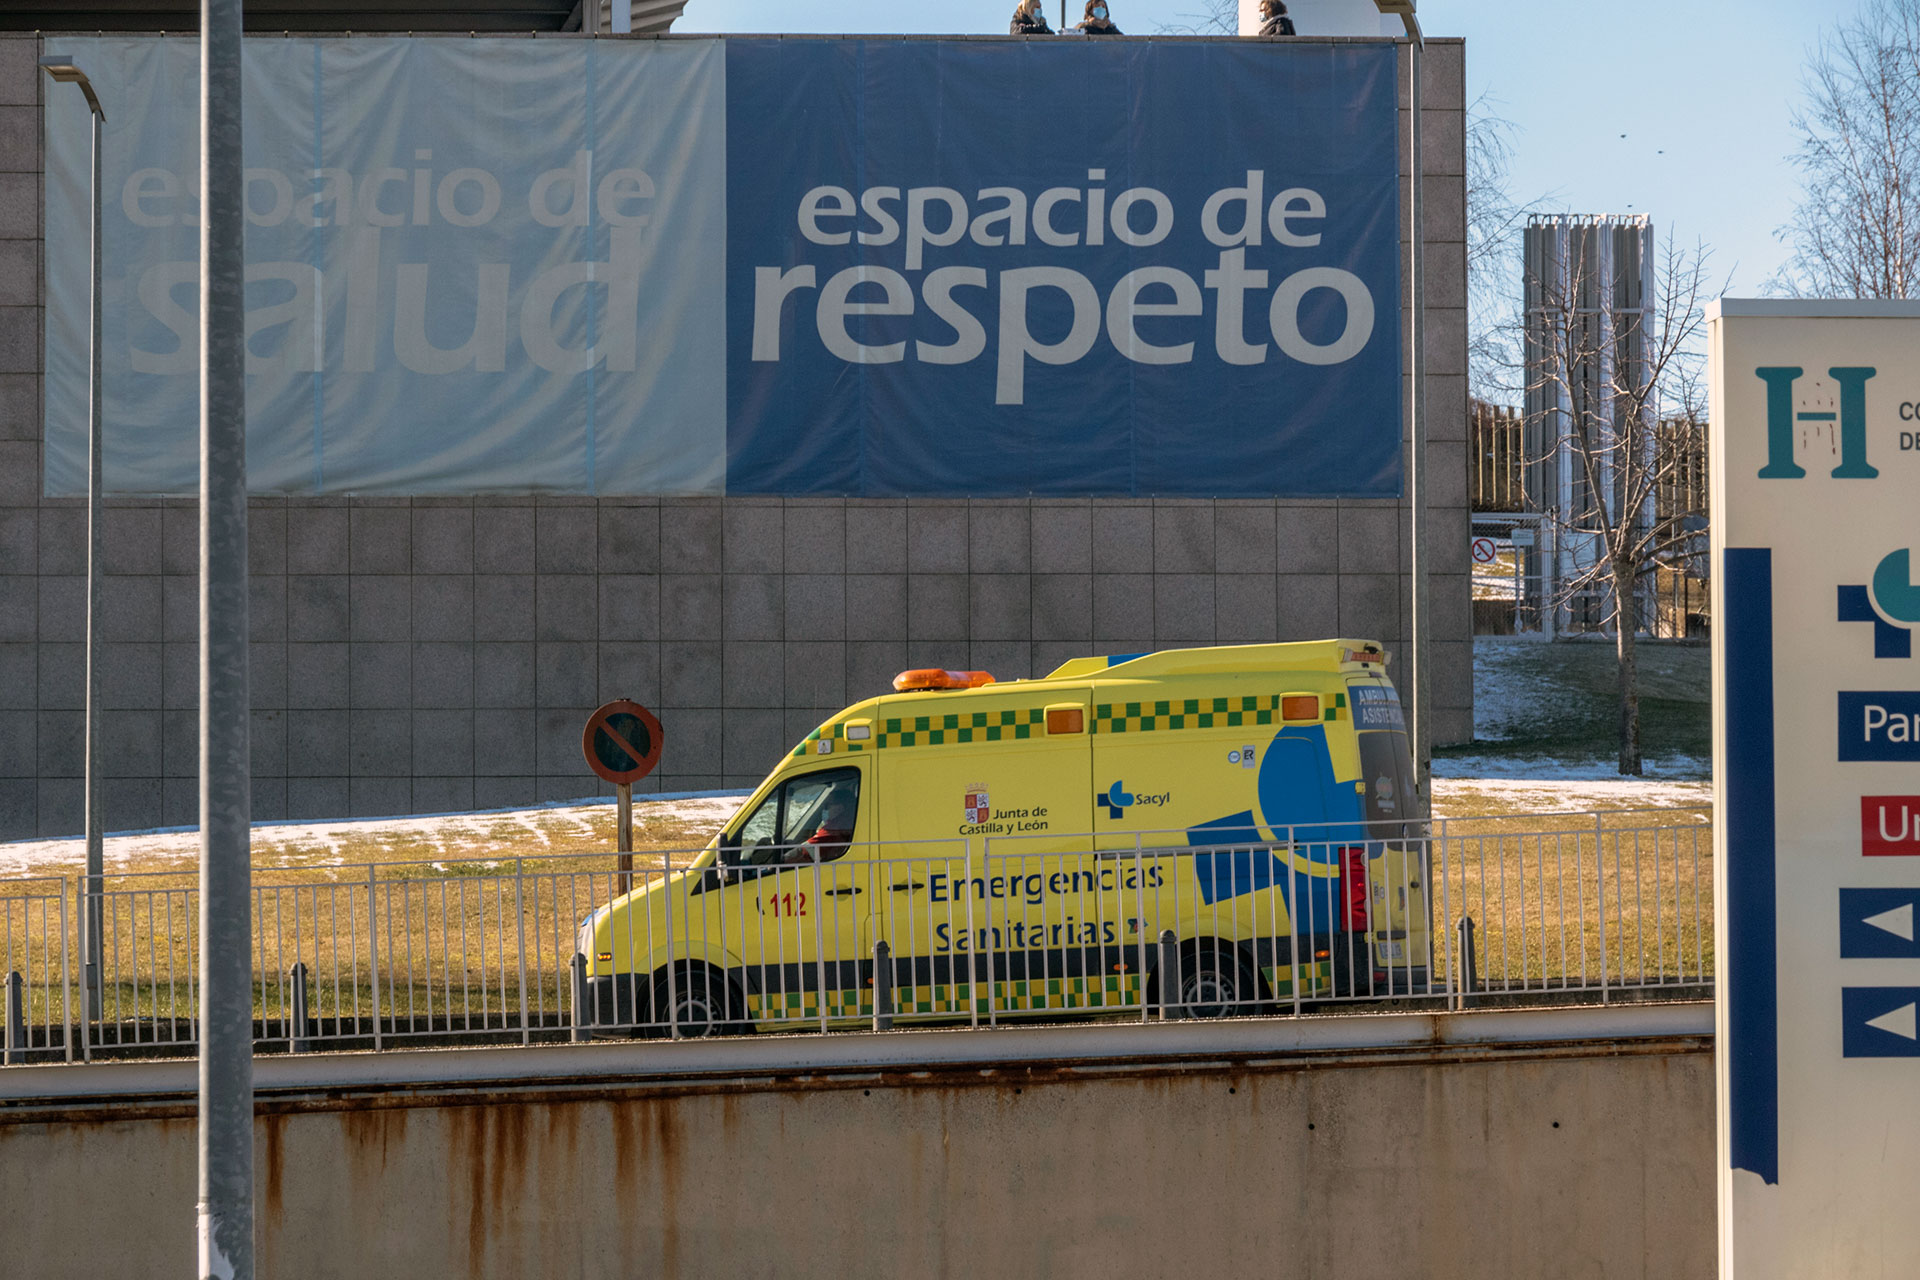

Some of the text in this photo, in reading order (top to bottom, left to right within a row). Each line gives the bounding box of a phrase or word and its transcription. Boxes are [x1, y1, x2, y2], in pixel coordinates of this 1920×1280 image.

[528, 150, 656, 228] de
[797, 168, 1327, 270] espacio de
[131, 226, 642, 375] salud
[751, 246, 1376, 405] respeto
[993, 806, 1048, 820] Junta de
[1135, 792, 1170, 807] Sacyl
[958, 820, 1049, 835] Castilla y León
[930, 861, 1164, 905] Emergencias
[770, 892, 807, 918] 112
[936, 916, 1116, 952] Sanitarias
